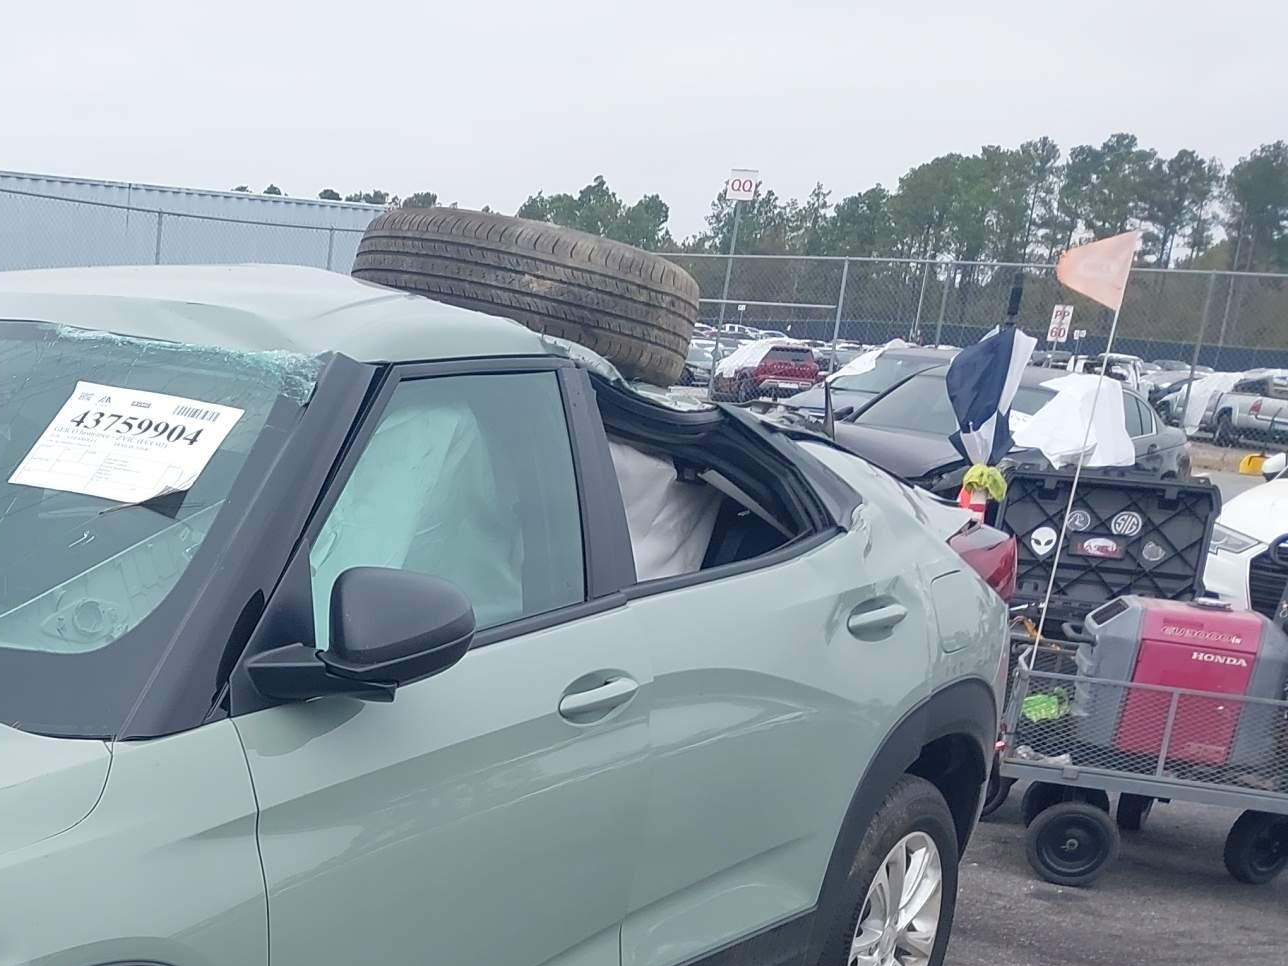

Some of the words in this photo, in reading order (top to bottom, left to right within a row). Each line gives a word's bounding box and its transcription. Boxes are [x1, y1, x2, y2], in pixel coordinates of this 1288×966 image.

[731, 178, 753, 193] QQ
[70, 409, 204, 446] 43759904
[1115, 514, 1138, 534] SIG
[1191, 651, 1248, 668] HONDA
